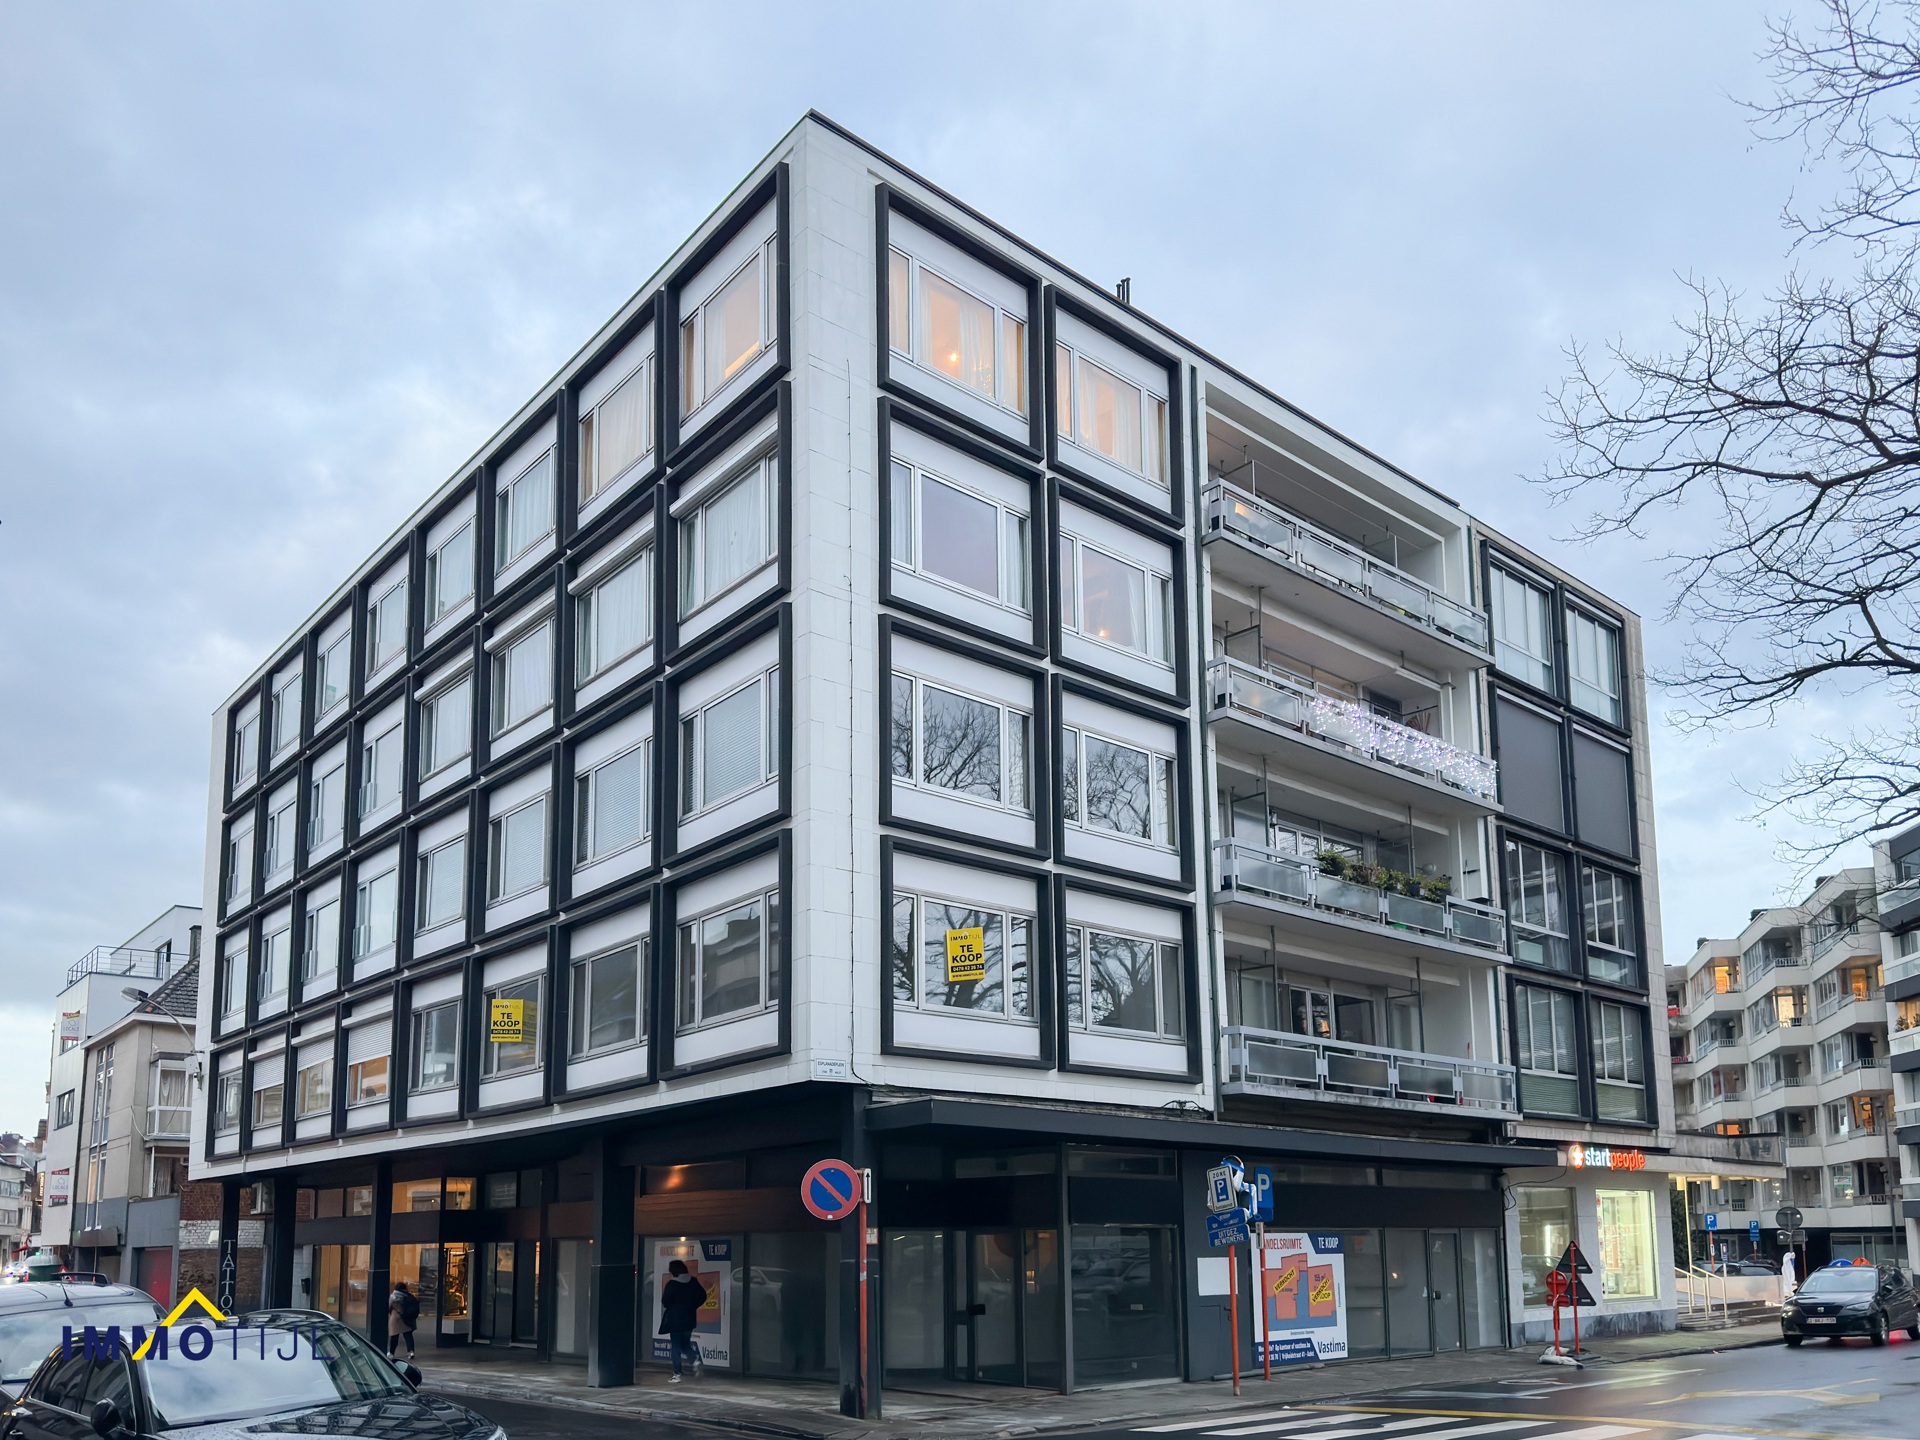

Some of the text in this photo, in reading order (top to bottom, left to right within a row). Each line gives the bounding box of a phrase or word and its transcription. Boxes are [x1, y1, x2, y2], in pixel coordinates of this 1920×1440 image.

[960, 944, 973, 953] TE
[952, 953, 982, 963] KOOP
[1585, 1147, 1645, 1171] startpeople
[1217, 1180, 1225, 1193] P
[1258, 1174, 1270, 1202] P
[1707, 1215, 1714, 1224] P
[1318, 1237, 1338, 1248] TE KOOP
[708, 1244, 727, 1256] TE KOOP
[1274, 1269, 1295, 1291] VERKOCHT
[1318, 1337, 1345, 1353] Vastima
[702, 1345, 728, 1360] Vastima
